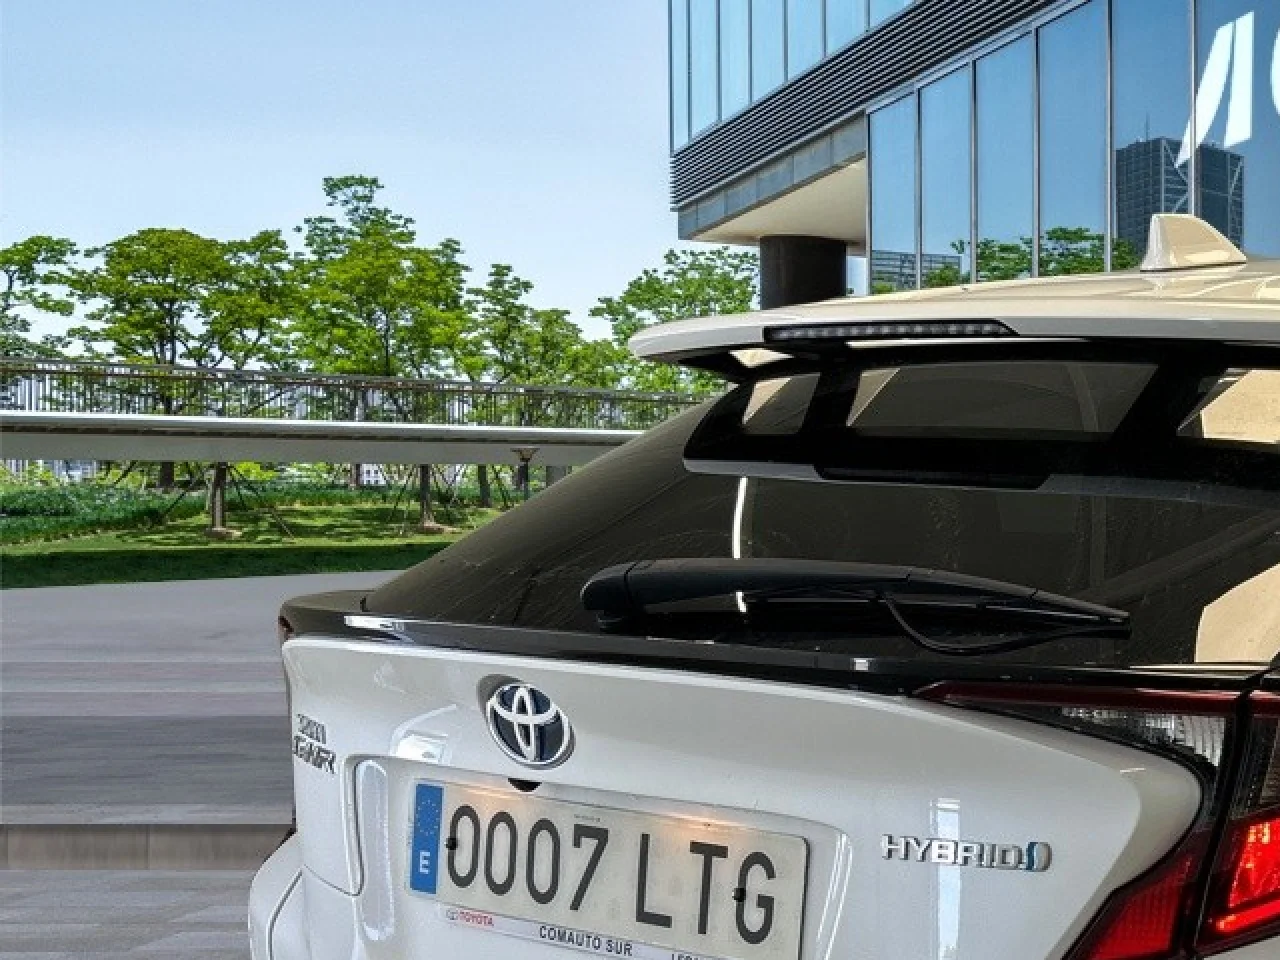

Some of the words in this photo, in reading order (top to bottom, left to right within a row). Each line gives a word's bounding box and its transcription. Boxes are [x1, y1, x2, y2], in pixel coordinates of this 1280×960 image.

[419, 851, 431, 875] E
[881, 833, 1023, 870] HYBRID
[447, 804, 609, 911] 0007
[635, 833, 776, 945] LTG
[459, 911, 494, 927] TOYOTA
[539, 925, 601, 951] COMAUTO
[606, 939, 633, 957] SUR
